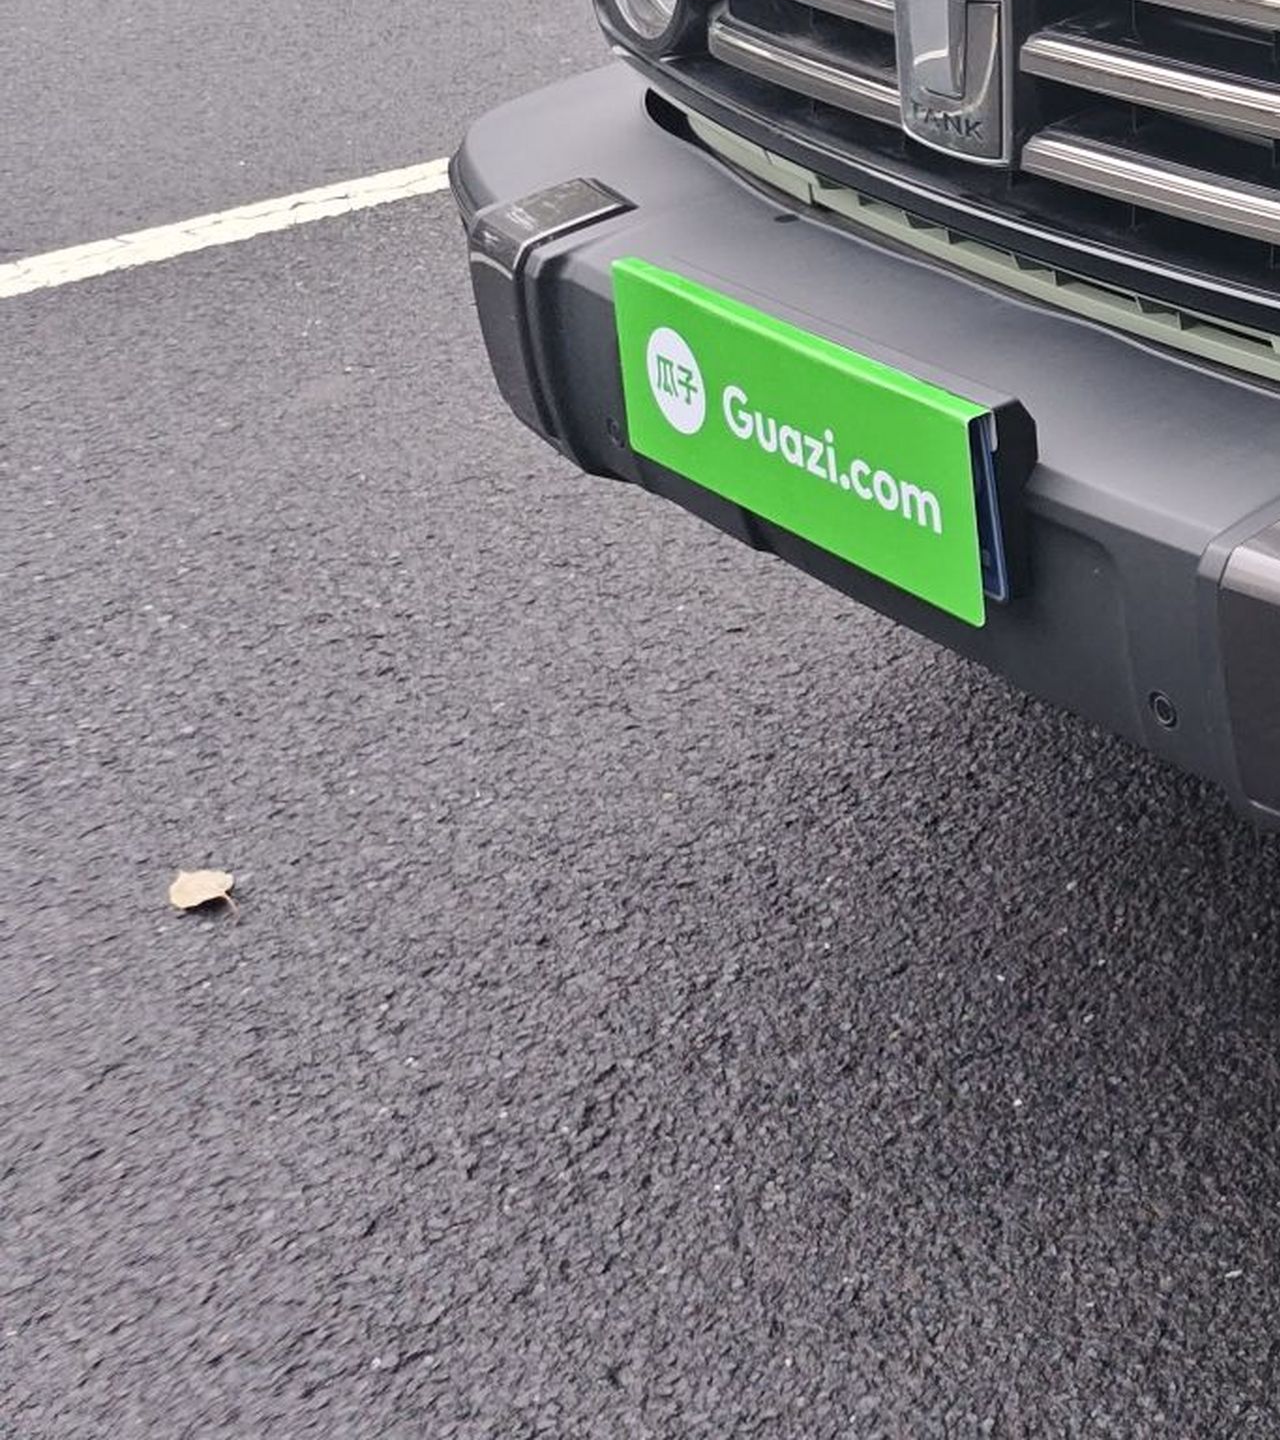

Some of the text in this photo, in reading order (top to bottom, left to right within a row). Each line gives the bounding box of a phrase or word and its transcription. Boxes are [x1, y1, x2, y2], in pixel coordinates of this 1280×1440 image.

[911, 101, 983, 141] TANK
[656, 355, 698, 405] 瓜子
[723, 385, 942, 534] Guazi.com
